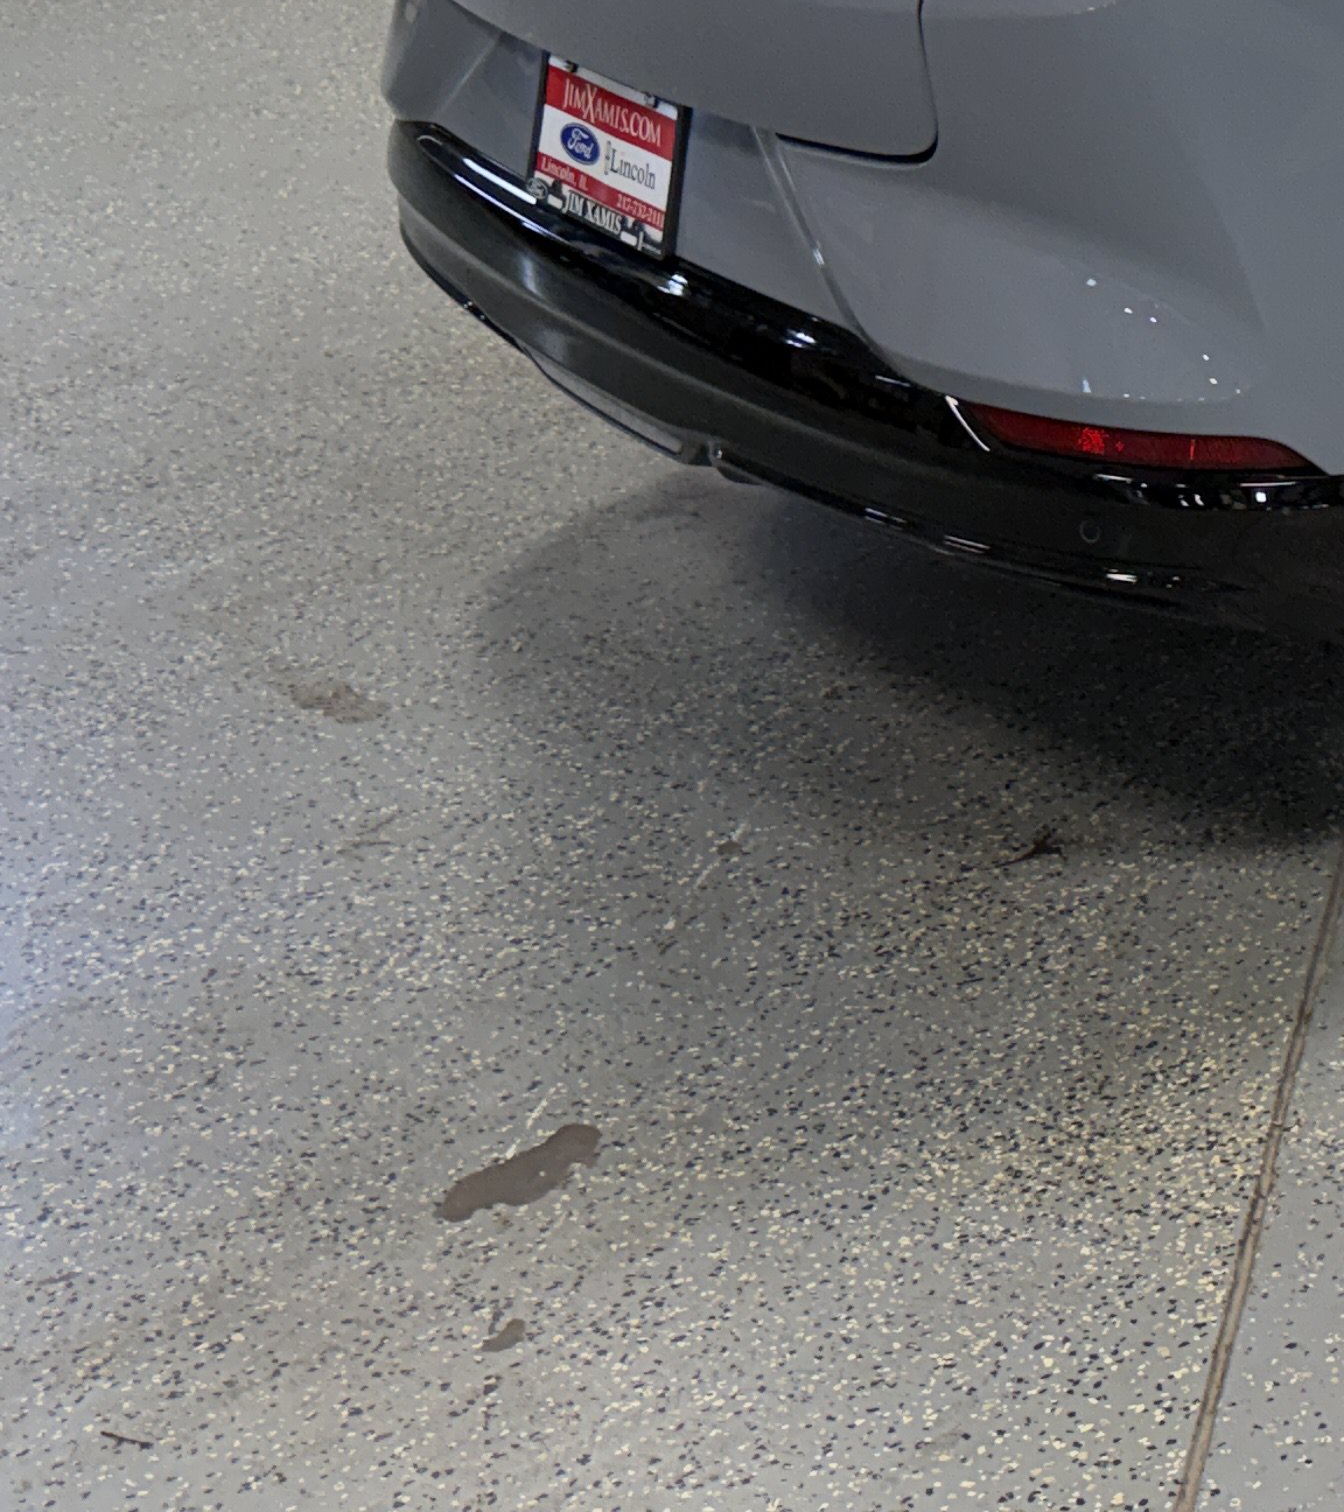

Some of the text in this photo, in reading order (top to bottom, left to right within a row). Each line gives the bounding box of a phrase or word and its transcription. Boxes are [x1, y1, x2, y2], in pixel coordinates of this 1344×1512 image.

[610, 148, 656, 190] Lincoln
[561, 189, 623, 235] JIM XAMIS
